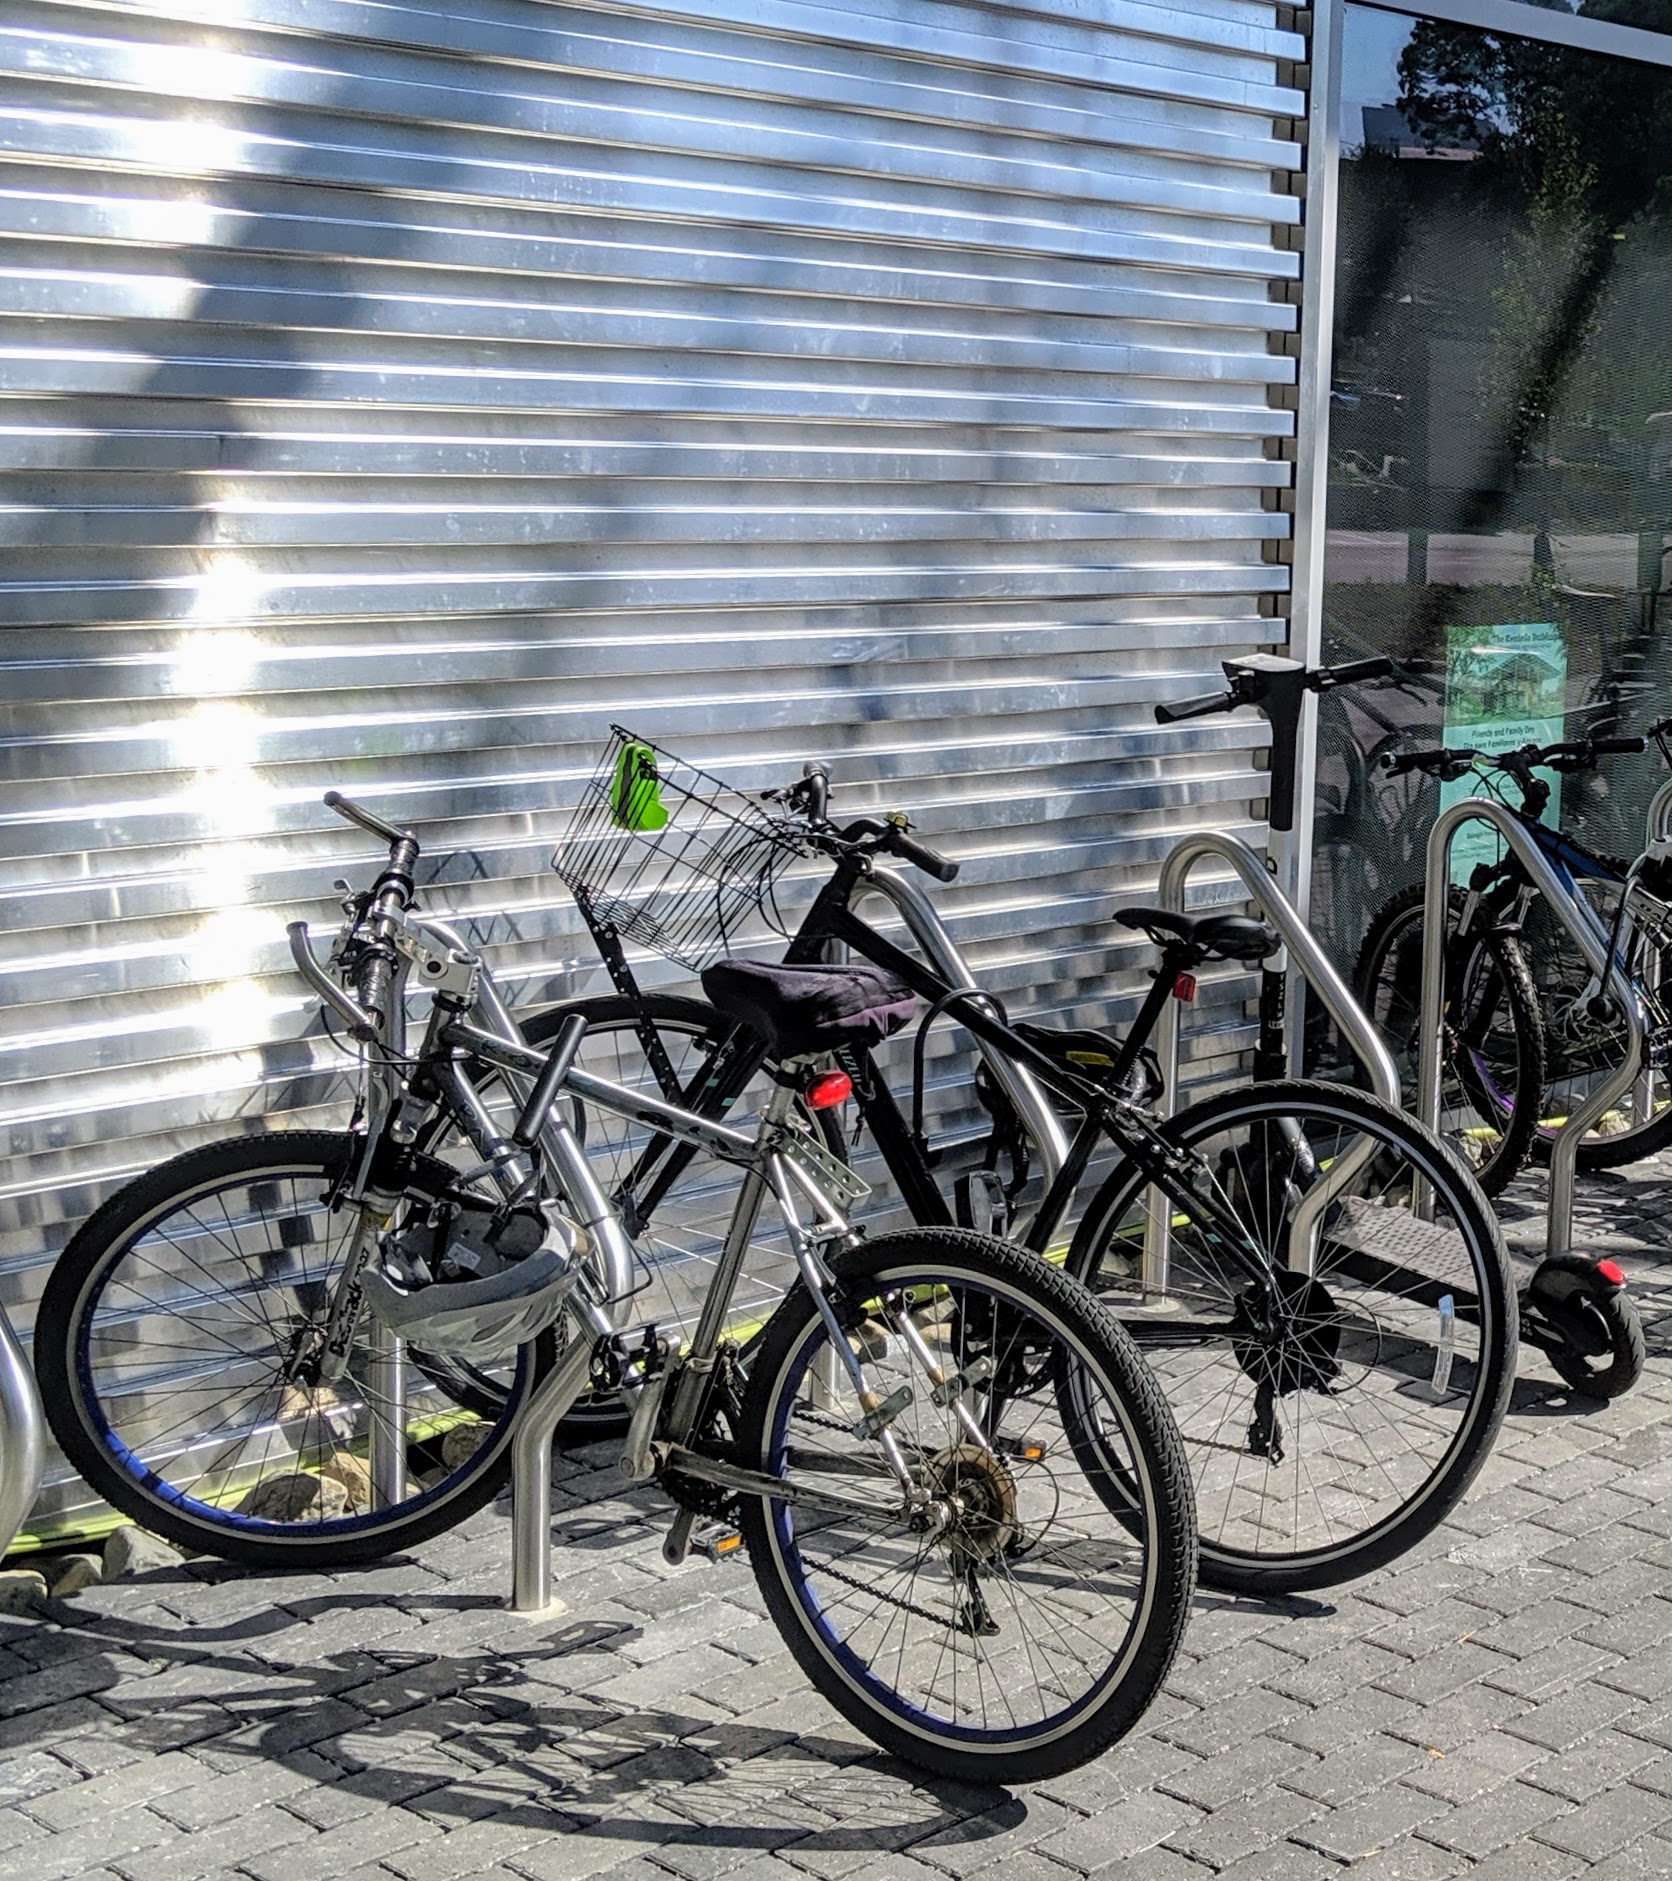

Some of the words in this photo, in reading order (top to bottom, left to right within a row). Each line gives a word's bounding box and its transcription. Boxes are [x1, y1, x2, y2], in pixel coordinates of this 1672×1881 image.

[1472, 730, 1493, 738] Friends
[1494, 728, 1504, 736] and
[1505, 726, 1523, 735] Family
[1524, 725, 1535, 735] Day
